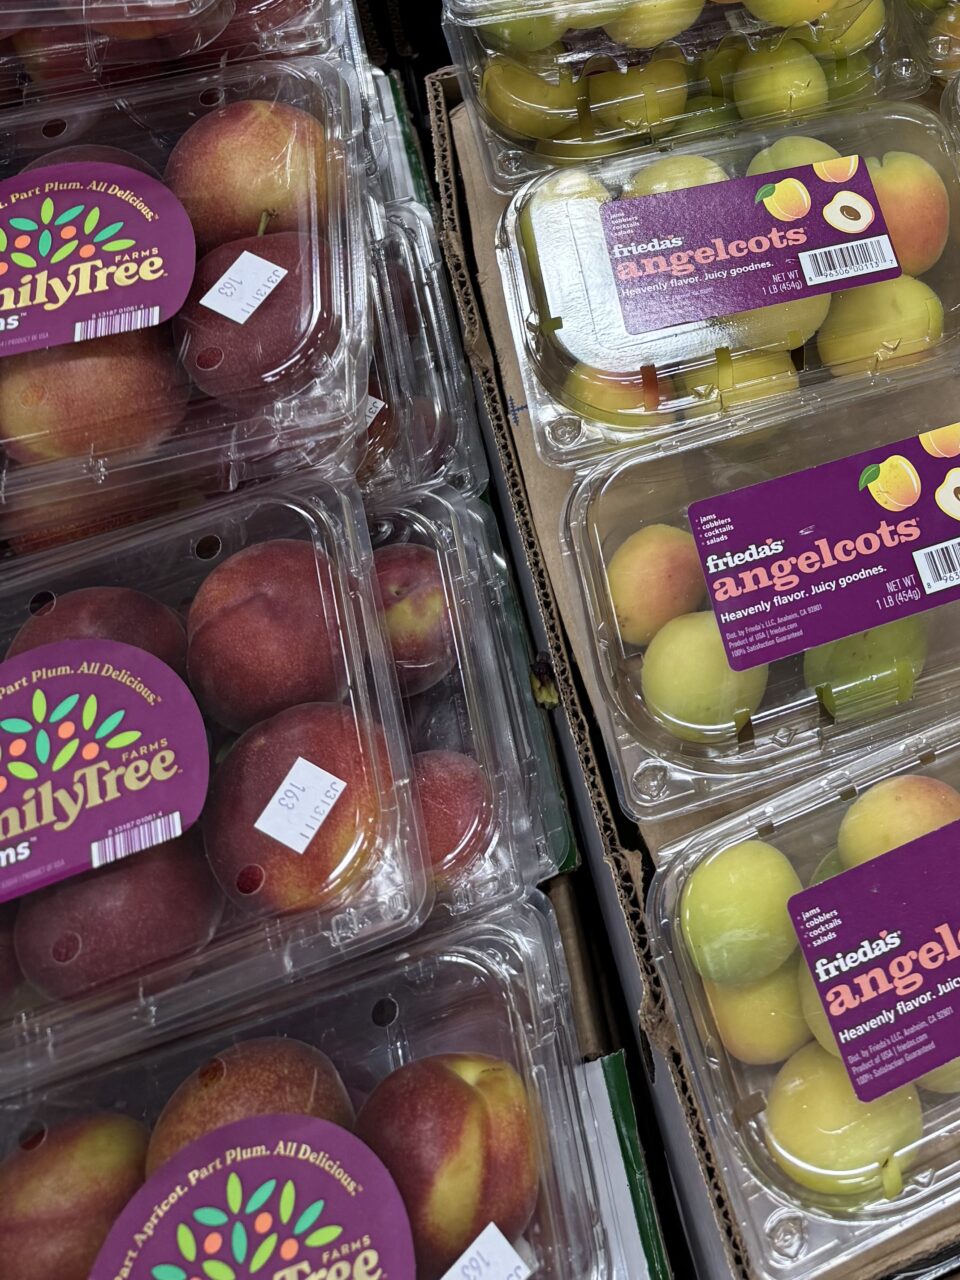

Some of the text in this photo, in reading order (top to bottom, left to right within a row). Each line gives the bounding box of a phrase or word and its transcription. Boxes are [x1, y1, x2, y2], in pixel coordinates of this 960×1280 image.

[10, 186, 41, 204] Part
[44, 181, 84, 193] Plum.
[86, 180, 107, 193] All
[115, 247, 159, 264] FARMS
[612, 234, 683, 258] frieda's
[616, 226, 807, 280] angelcots
[621, 281, 667, 297] Heavenly
[669, 275, 702, 287] flavor.
[704, 270, 727, 280] Juicy
[729, 260, 774, 276] goodnes.
[705, 538, 783, 573] frieda's
[712, 518, 920, 601] angelcots
[720, 565, 886, 623] Heavenly flavor. Juicy goodnes.
[875, 587, 921, 609] 1 LB (454g)
[885, 574, 916, 592] NET WT
[0, 676, 28, 699] Part
[32, 665, 75, 683] Plum.
[78, 661, 100, 674] All
[122, 738, 168, 762] FARMS
[278, 780, 306, 812] 163
[801, 906, 820, 920] jams
[805, 909, 837, 928] cobblers
[808, 918, 842, 937] cocktails
[812, 931, 836, 946] salads
[815, 930, 900, 982] frieda's
[838, 1009, 894, 1043] Heavenly
[895, 991, 936, 1014] flavor.
[133, 1184, 188, 1247] Apricot.
[187, 1157, 222, 1186] Part
[225, 1143, 270, 1166] Plum.
[273, 1140, 297, 1157] All
[321, 1234, 372, 1264] FARMS
